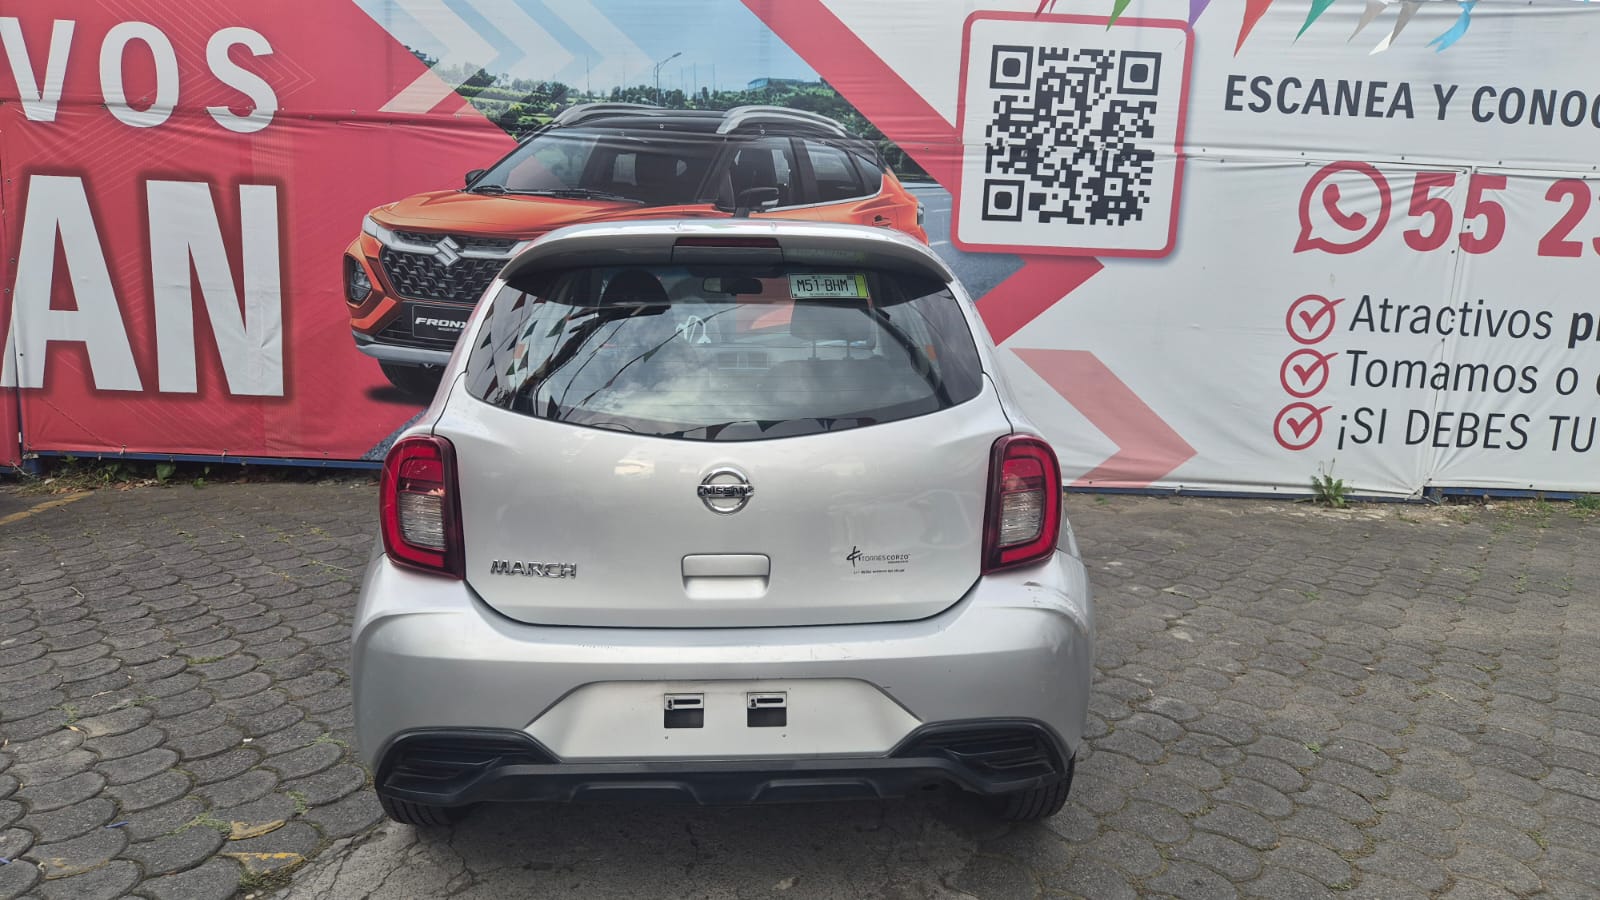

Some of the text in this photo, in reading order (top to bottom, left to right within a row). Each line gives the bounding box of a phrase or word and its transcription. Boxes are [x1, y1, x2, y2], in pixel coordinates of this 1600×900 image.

[0, 16, 278, 133] VOS
[1224, 74, 1415, 119] ESCANEA
[1433, 84, 1459, 121] Y
[1403, 171, 1600, 258] 55 2
[0, 174, 285, 397] AN
[796, 279, 849, 292] M51-BHM
[1349, 294, 1553, 340] Atractivos
[1346, 350, 1539, 394] Tomamos
[1556, 367, 1579, 395] o
[1337, 406, 1597, 453] ¡SI DEBES TU
[703, 487, 748, 495] NISSAN
[490, 560, 577, 579] MARCH
